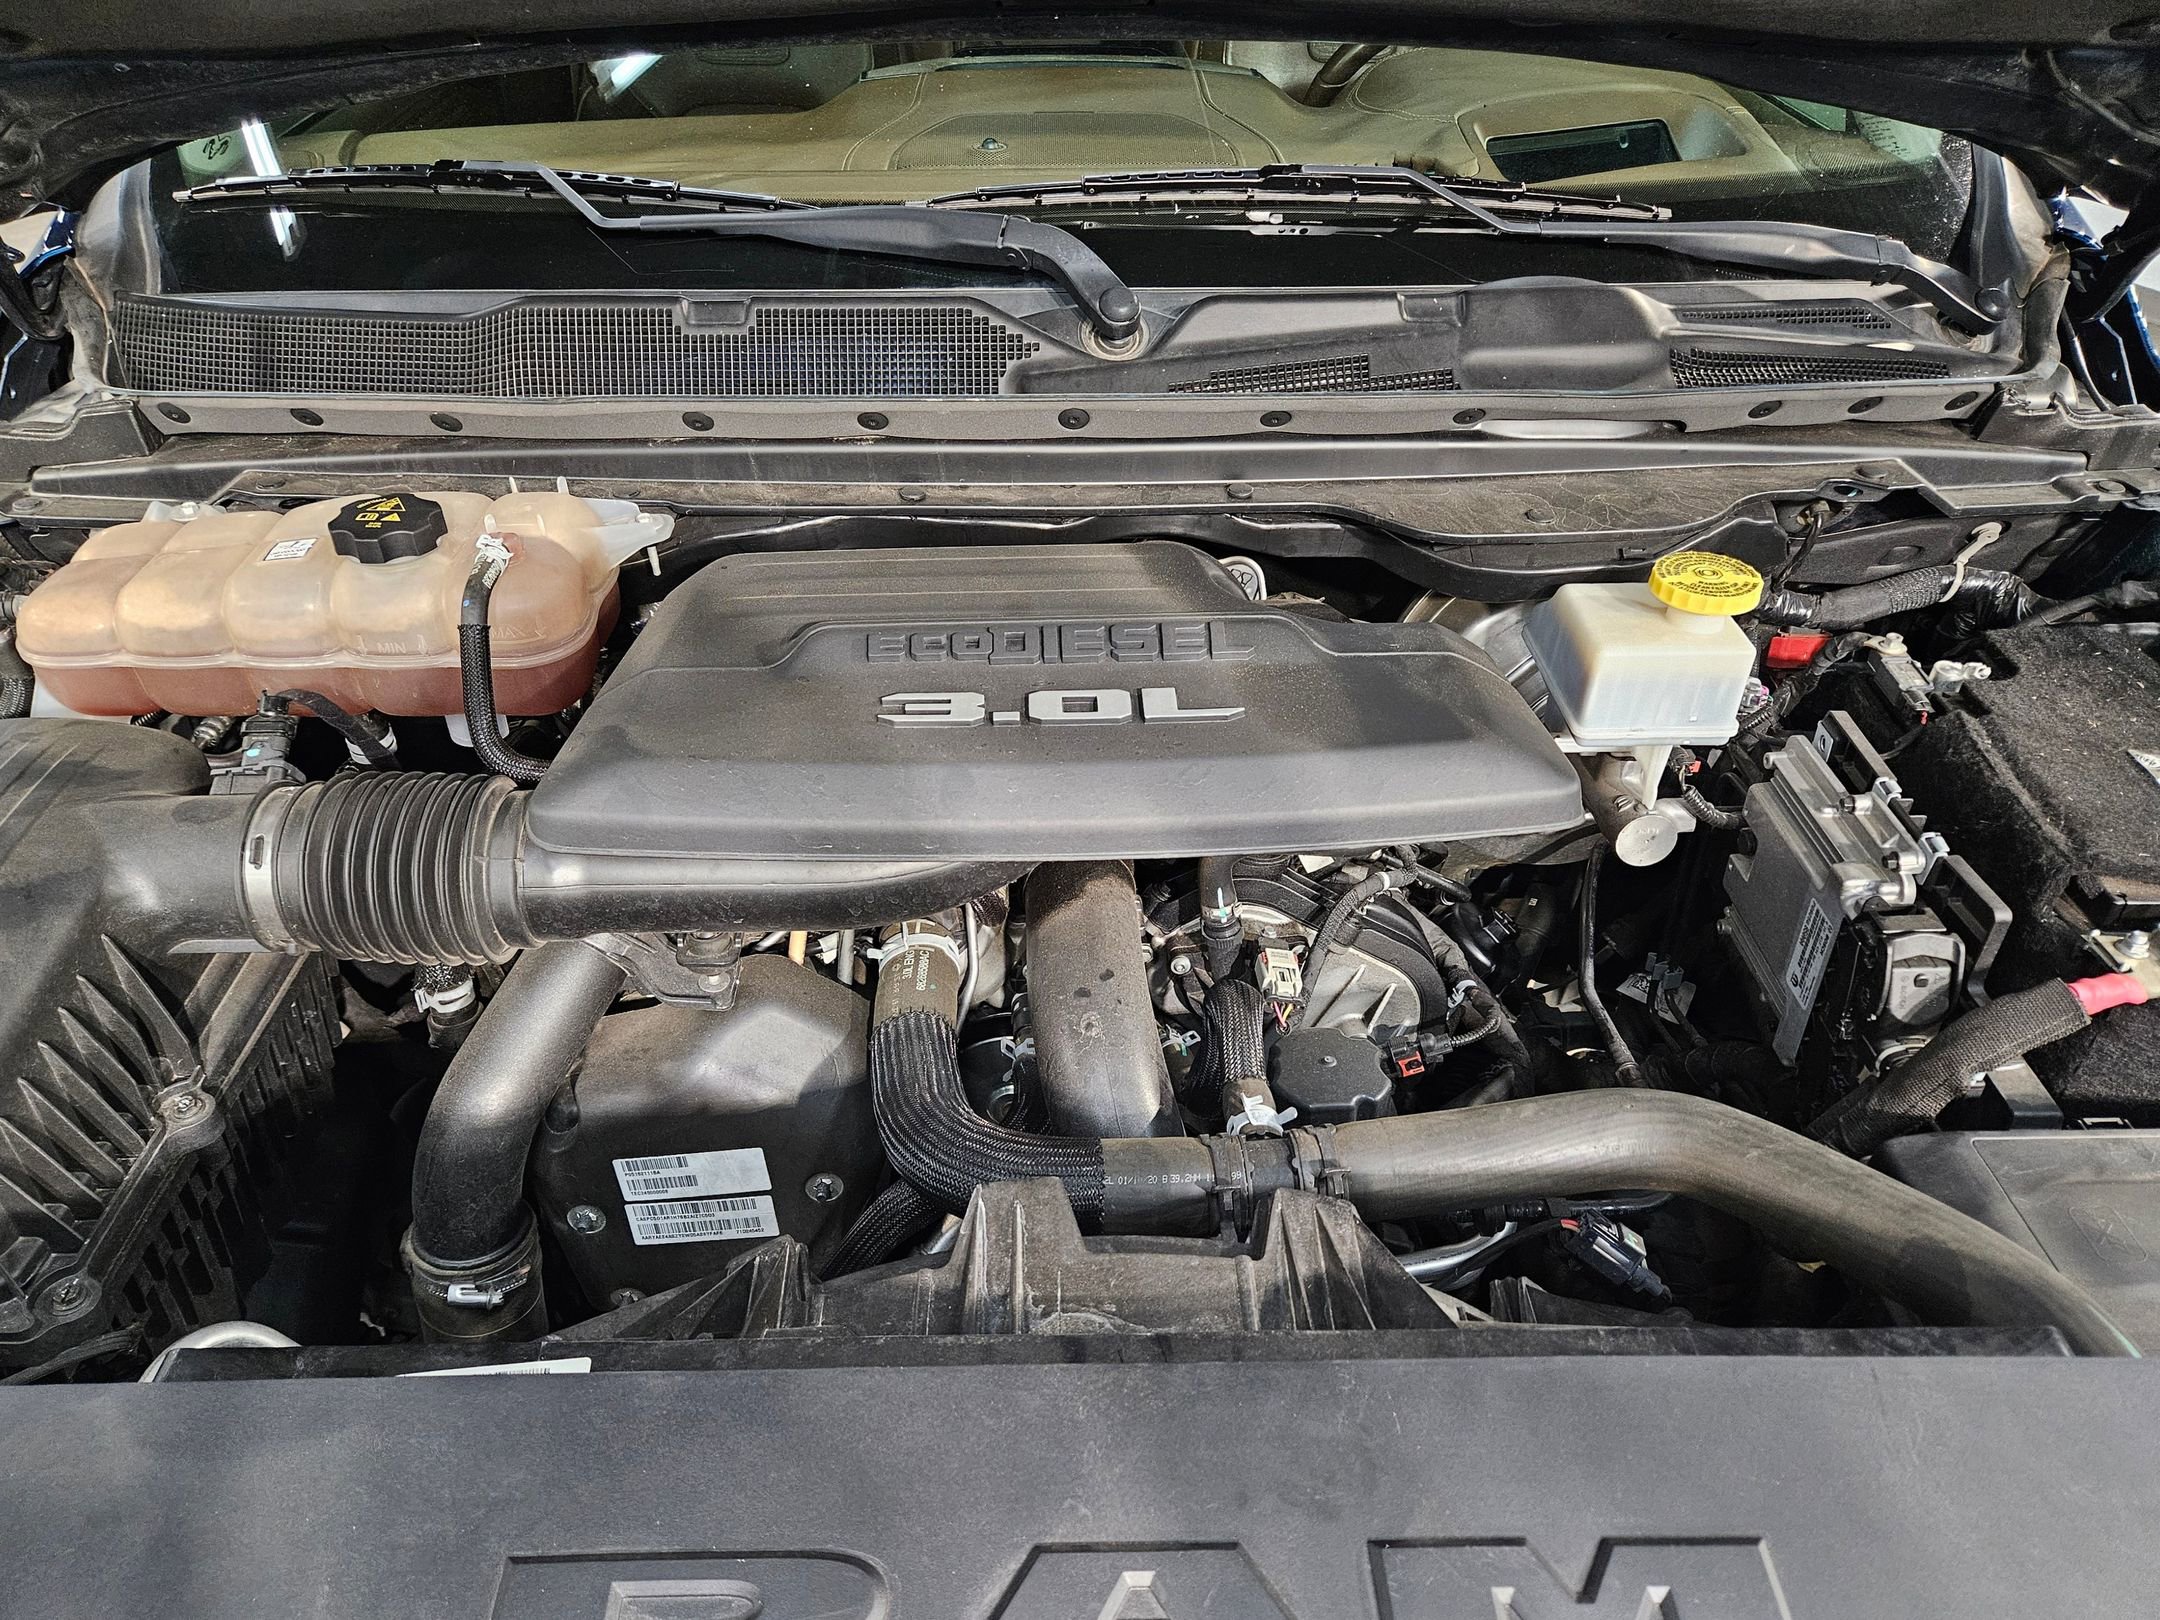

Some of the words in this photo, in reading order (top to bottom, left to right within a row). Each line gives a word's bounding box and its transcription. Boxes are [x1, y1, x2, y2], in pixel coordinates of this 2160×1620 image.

[376, 641, 407, 654] MIN
[867, 620, 1256, 665] ECODIESEL
[876, 687, 1246, 728] 3.0L
[903, 949, 915, 966] ENG
